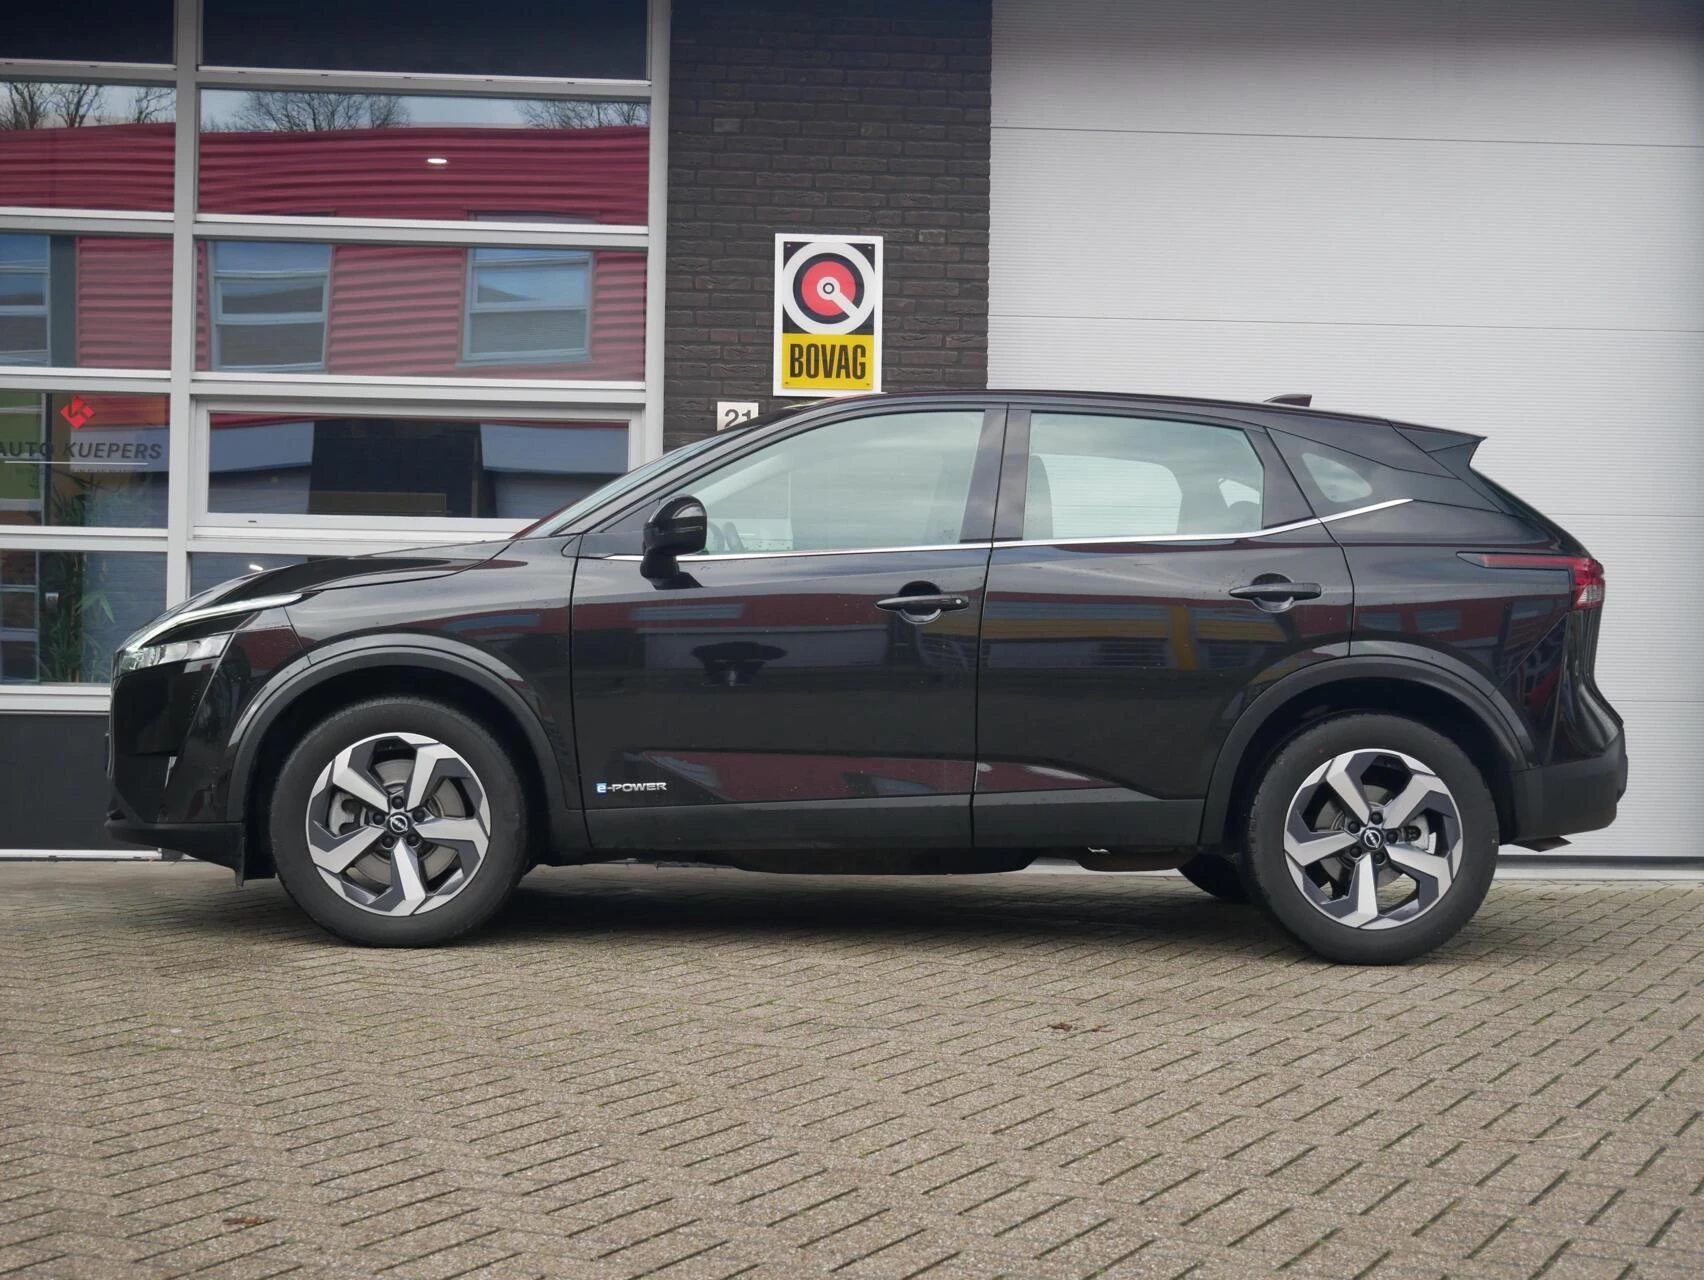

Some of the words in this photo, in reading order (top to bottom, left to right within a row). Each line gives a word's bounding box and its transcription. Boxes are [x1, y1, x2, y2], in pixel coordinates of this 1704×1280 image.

[789, 343, 867, 379] BOVAG
[723, 408, 752, 428] 21
[0, 441, 54, 458] AUTO
[63, 442, 162, 460] KUEPERS
[595, 781, 667, 794] e-POWER
